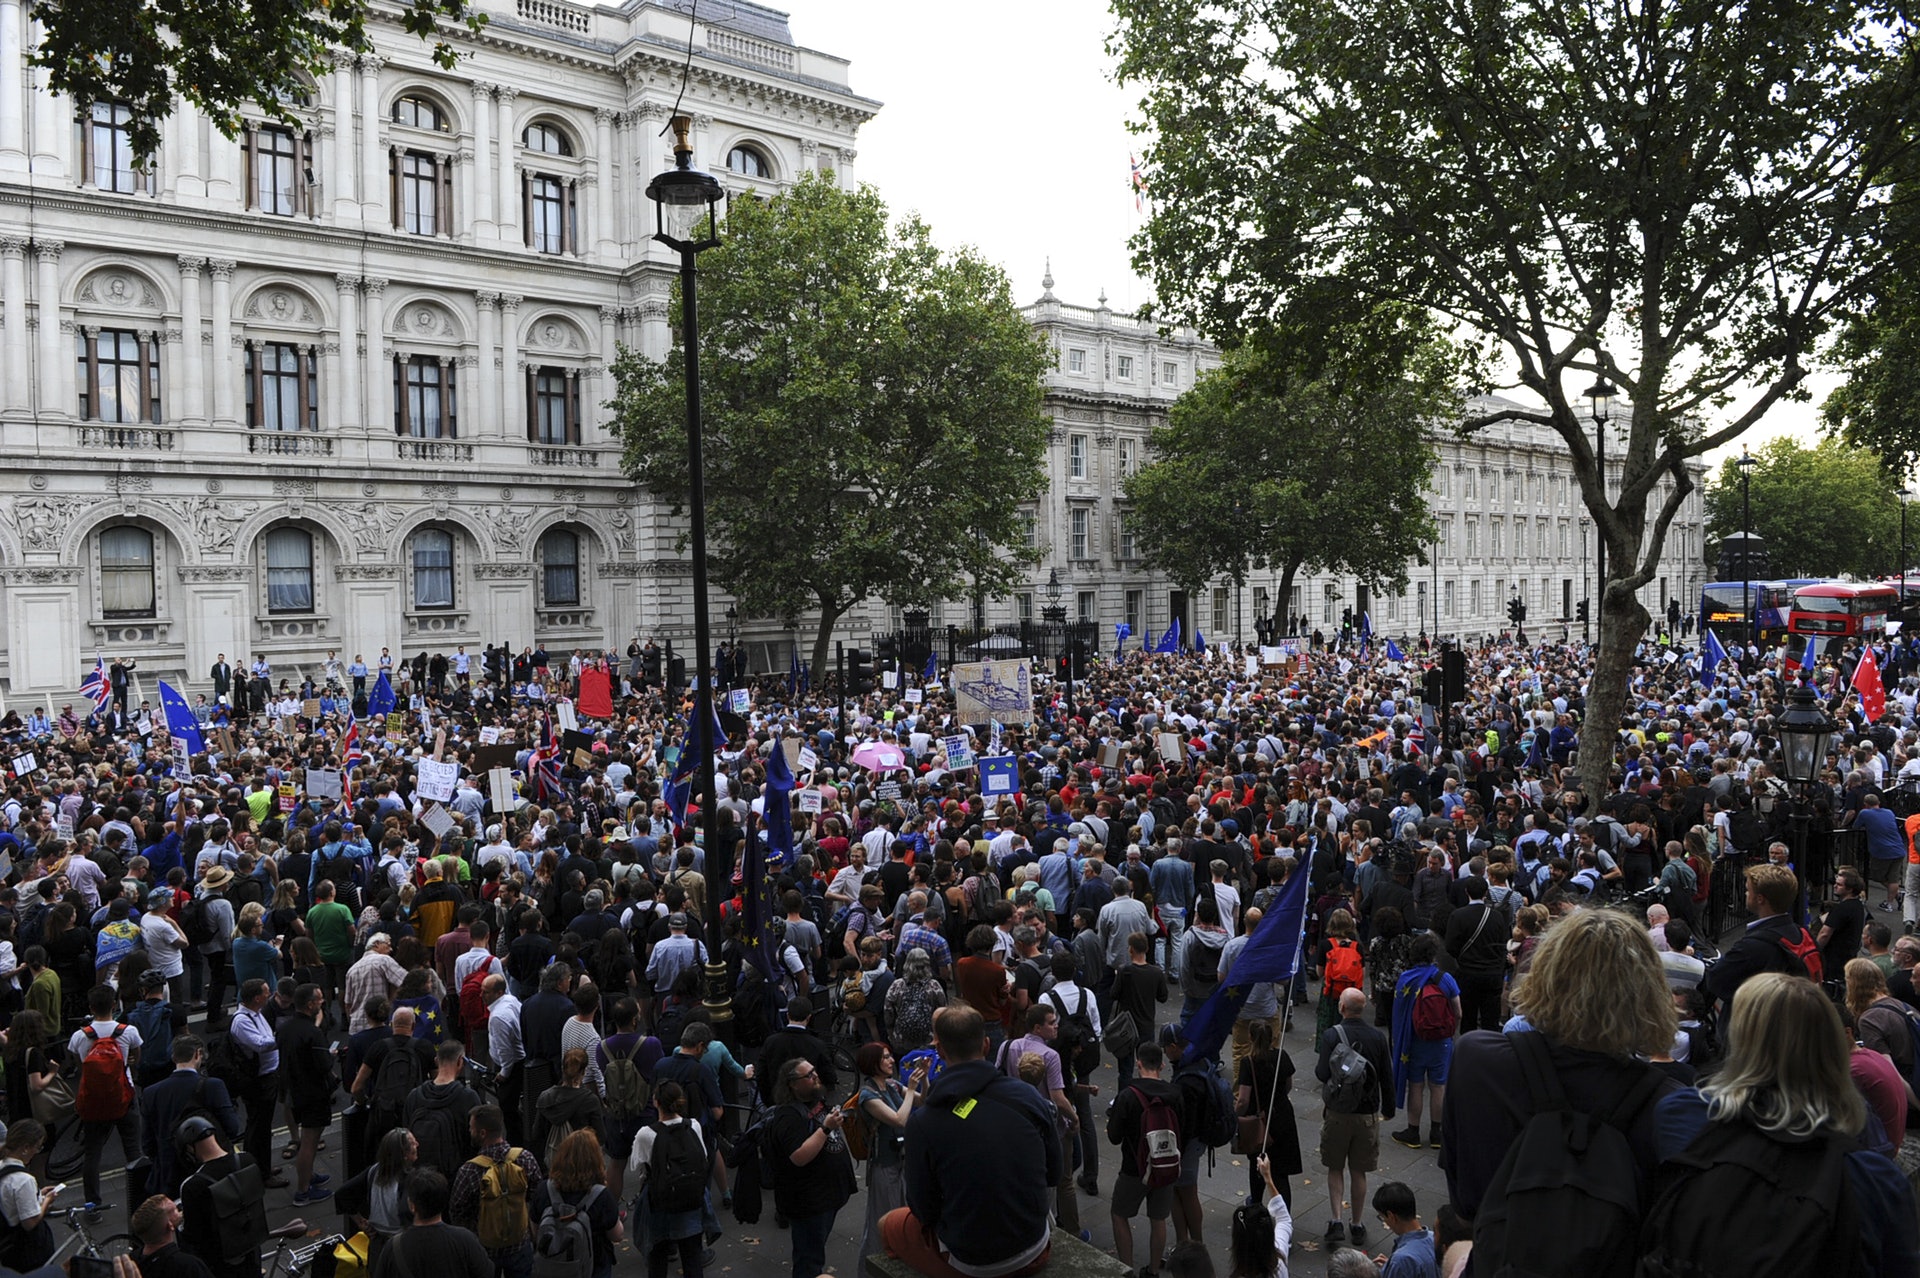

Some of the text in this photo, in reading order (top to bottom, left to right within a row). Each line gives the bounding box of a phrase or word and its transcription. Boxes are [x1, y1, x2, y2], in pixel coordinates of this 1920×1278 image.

[962, 666, 982, 681] TO
[947, 743, 962, 751] STOP
[949, 755, 964, 763] STOP
[1157, 1141, 1169, 1150] NB
